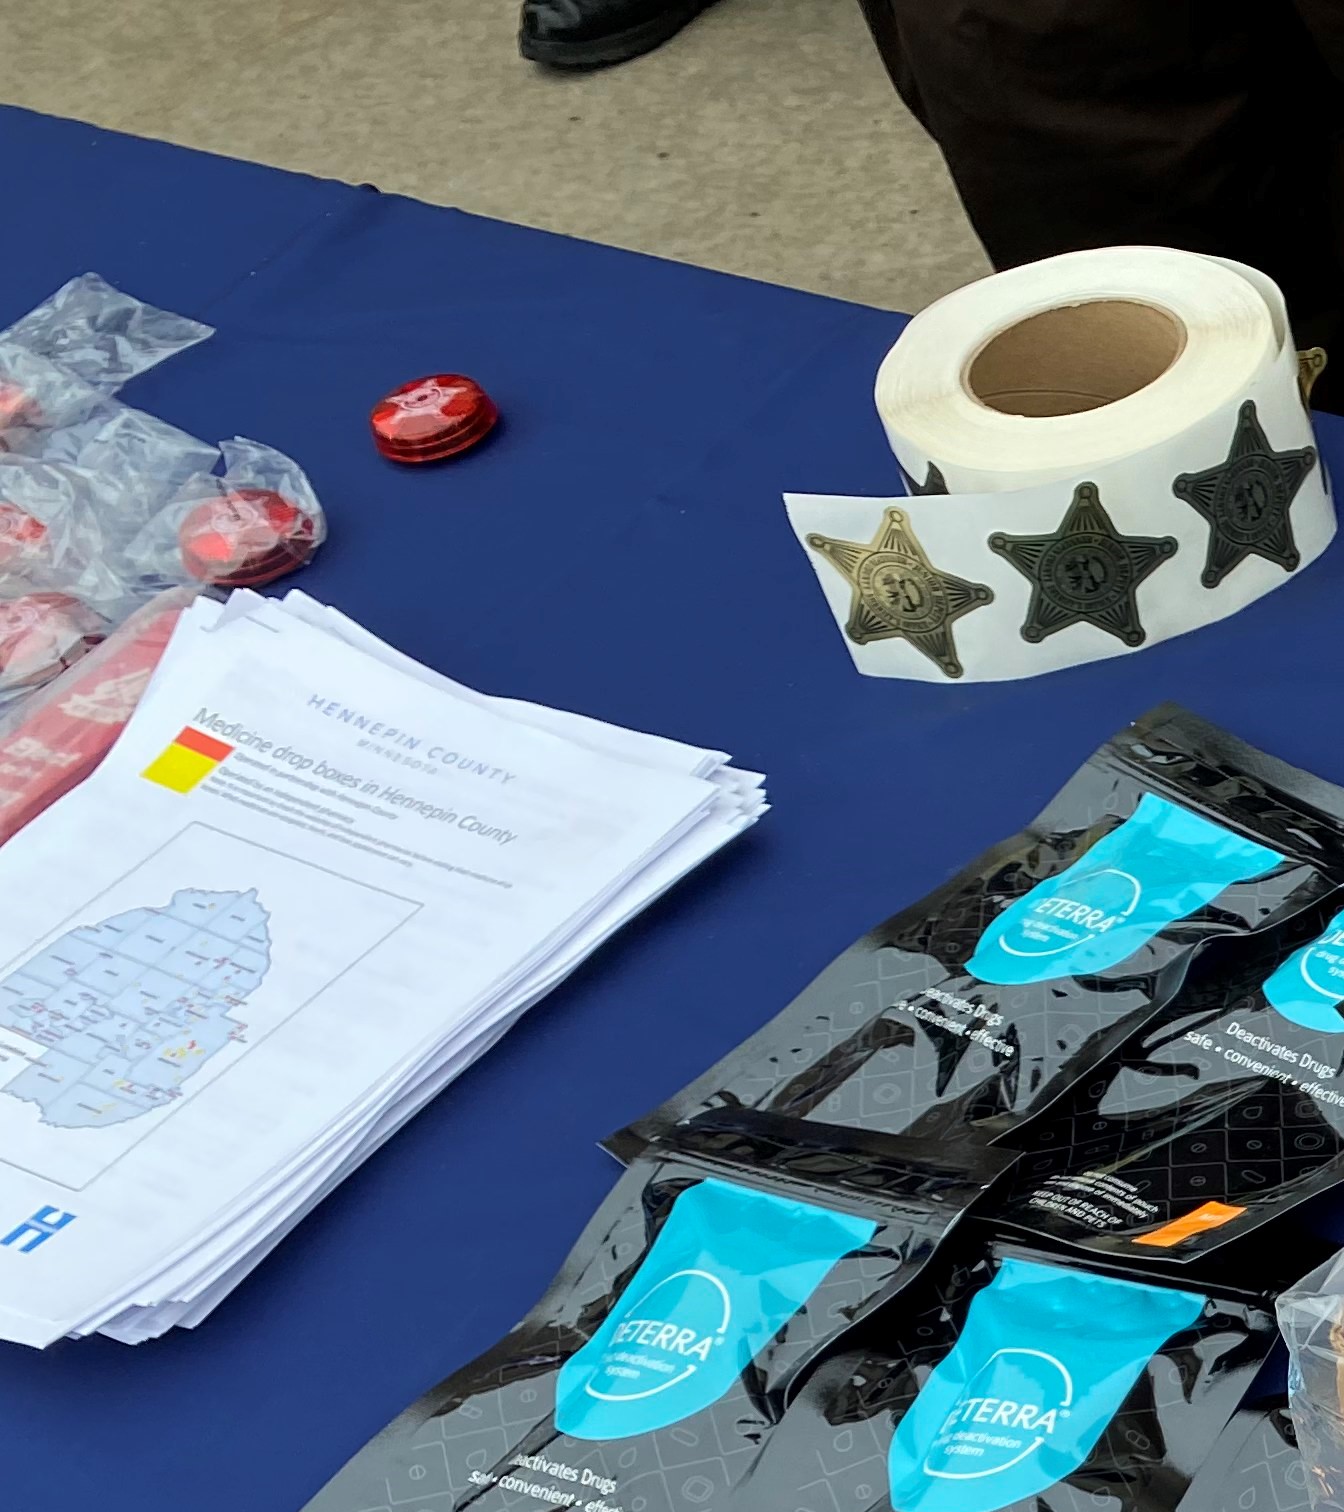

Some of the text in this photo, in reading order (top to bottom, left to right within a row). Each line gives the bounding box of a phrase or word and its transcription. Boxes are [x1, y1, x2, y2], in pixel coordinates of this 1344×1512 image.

[307, 694, 515, 783] HENNEPIN COUNTY
[193, 707, 517, 845] Medicine drop boxes in Hennepin County
[914, 1006, 1014, 1056] convenient effective
[973, 1003, 1004, 1026] Drugs
[1183, 1030, 1213, 1050] safe
[1226, 1021, 1336, 1079] Deactivates Drugs
[498, 1475, 574, 1505] convenient
[580, 1468, 616, 1495] Drugs
